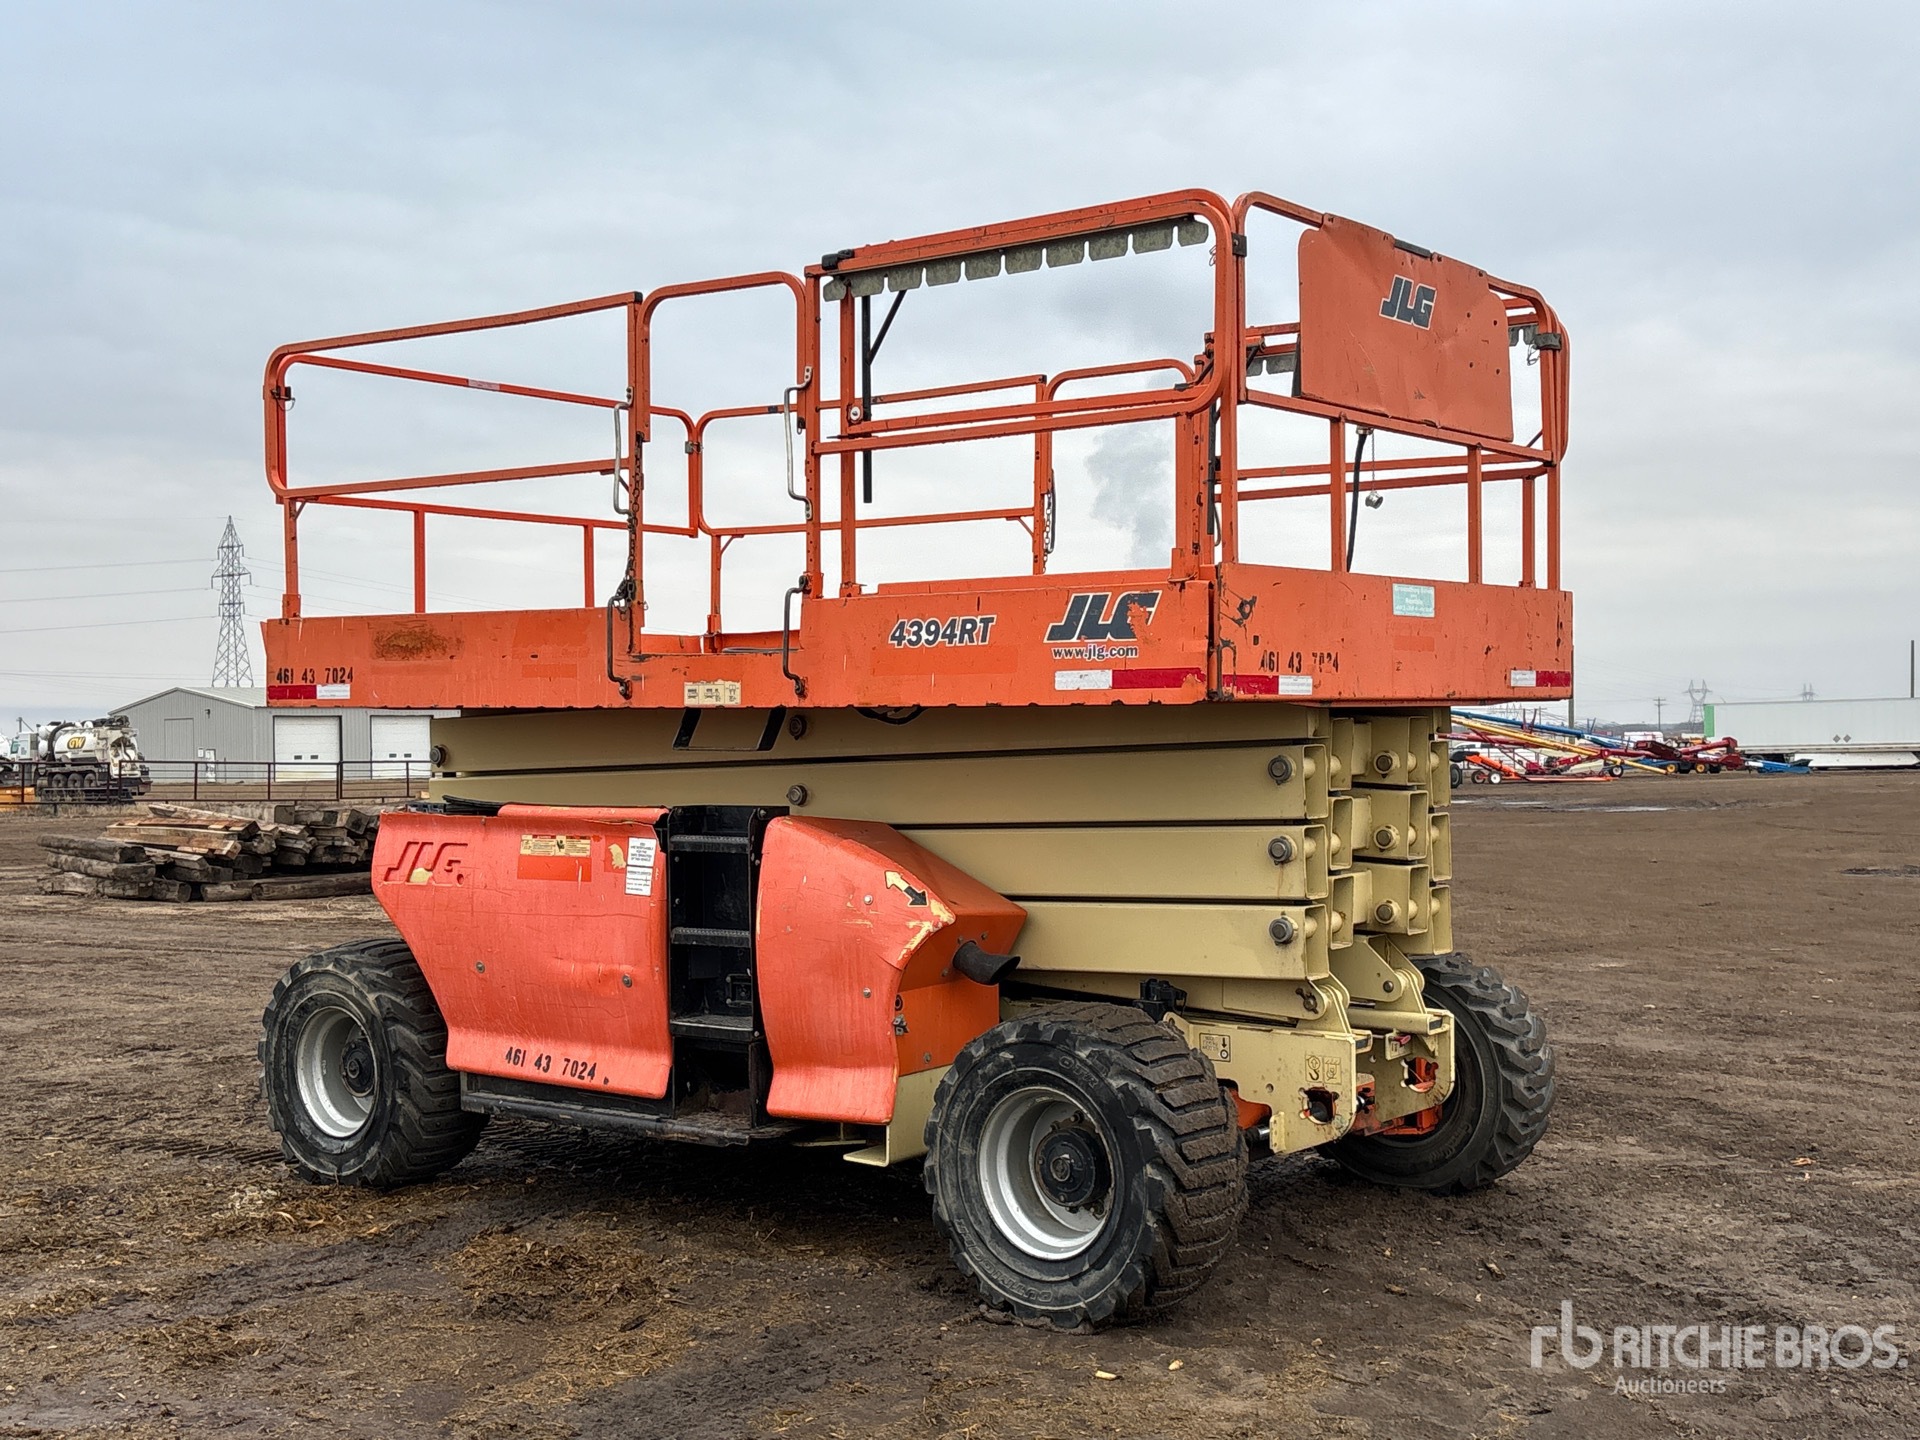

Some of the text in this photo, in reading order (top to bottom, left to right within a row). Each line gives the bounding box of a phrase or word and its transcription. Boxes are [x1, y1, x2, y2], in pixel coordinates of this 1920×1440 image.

[1379, 274, 1437, 330] JLG
[888, 615, 997, 648] 4394RT
[1043, 590, 1162, 643] JLG
[1052, 644, 1139, 661] www.jlg.com
[1288, 651, 1302, 673] 43
[276, 667, 353, 684] 461 43 7024
[505, 1046, 597, 1082] 461 43 7024
